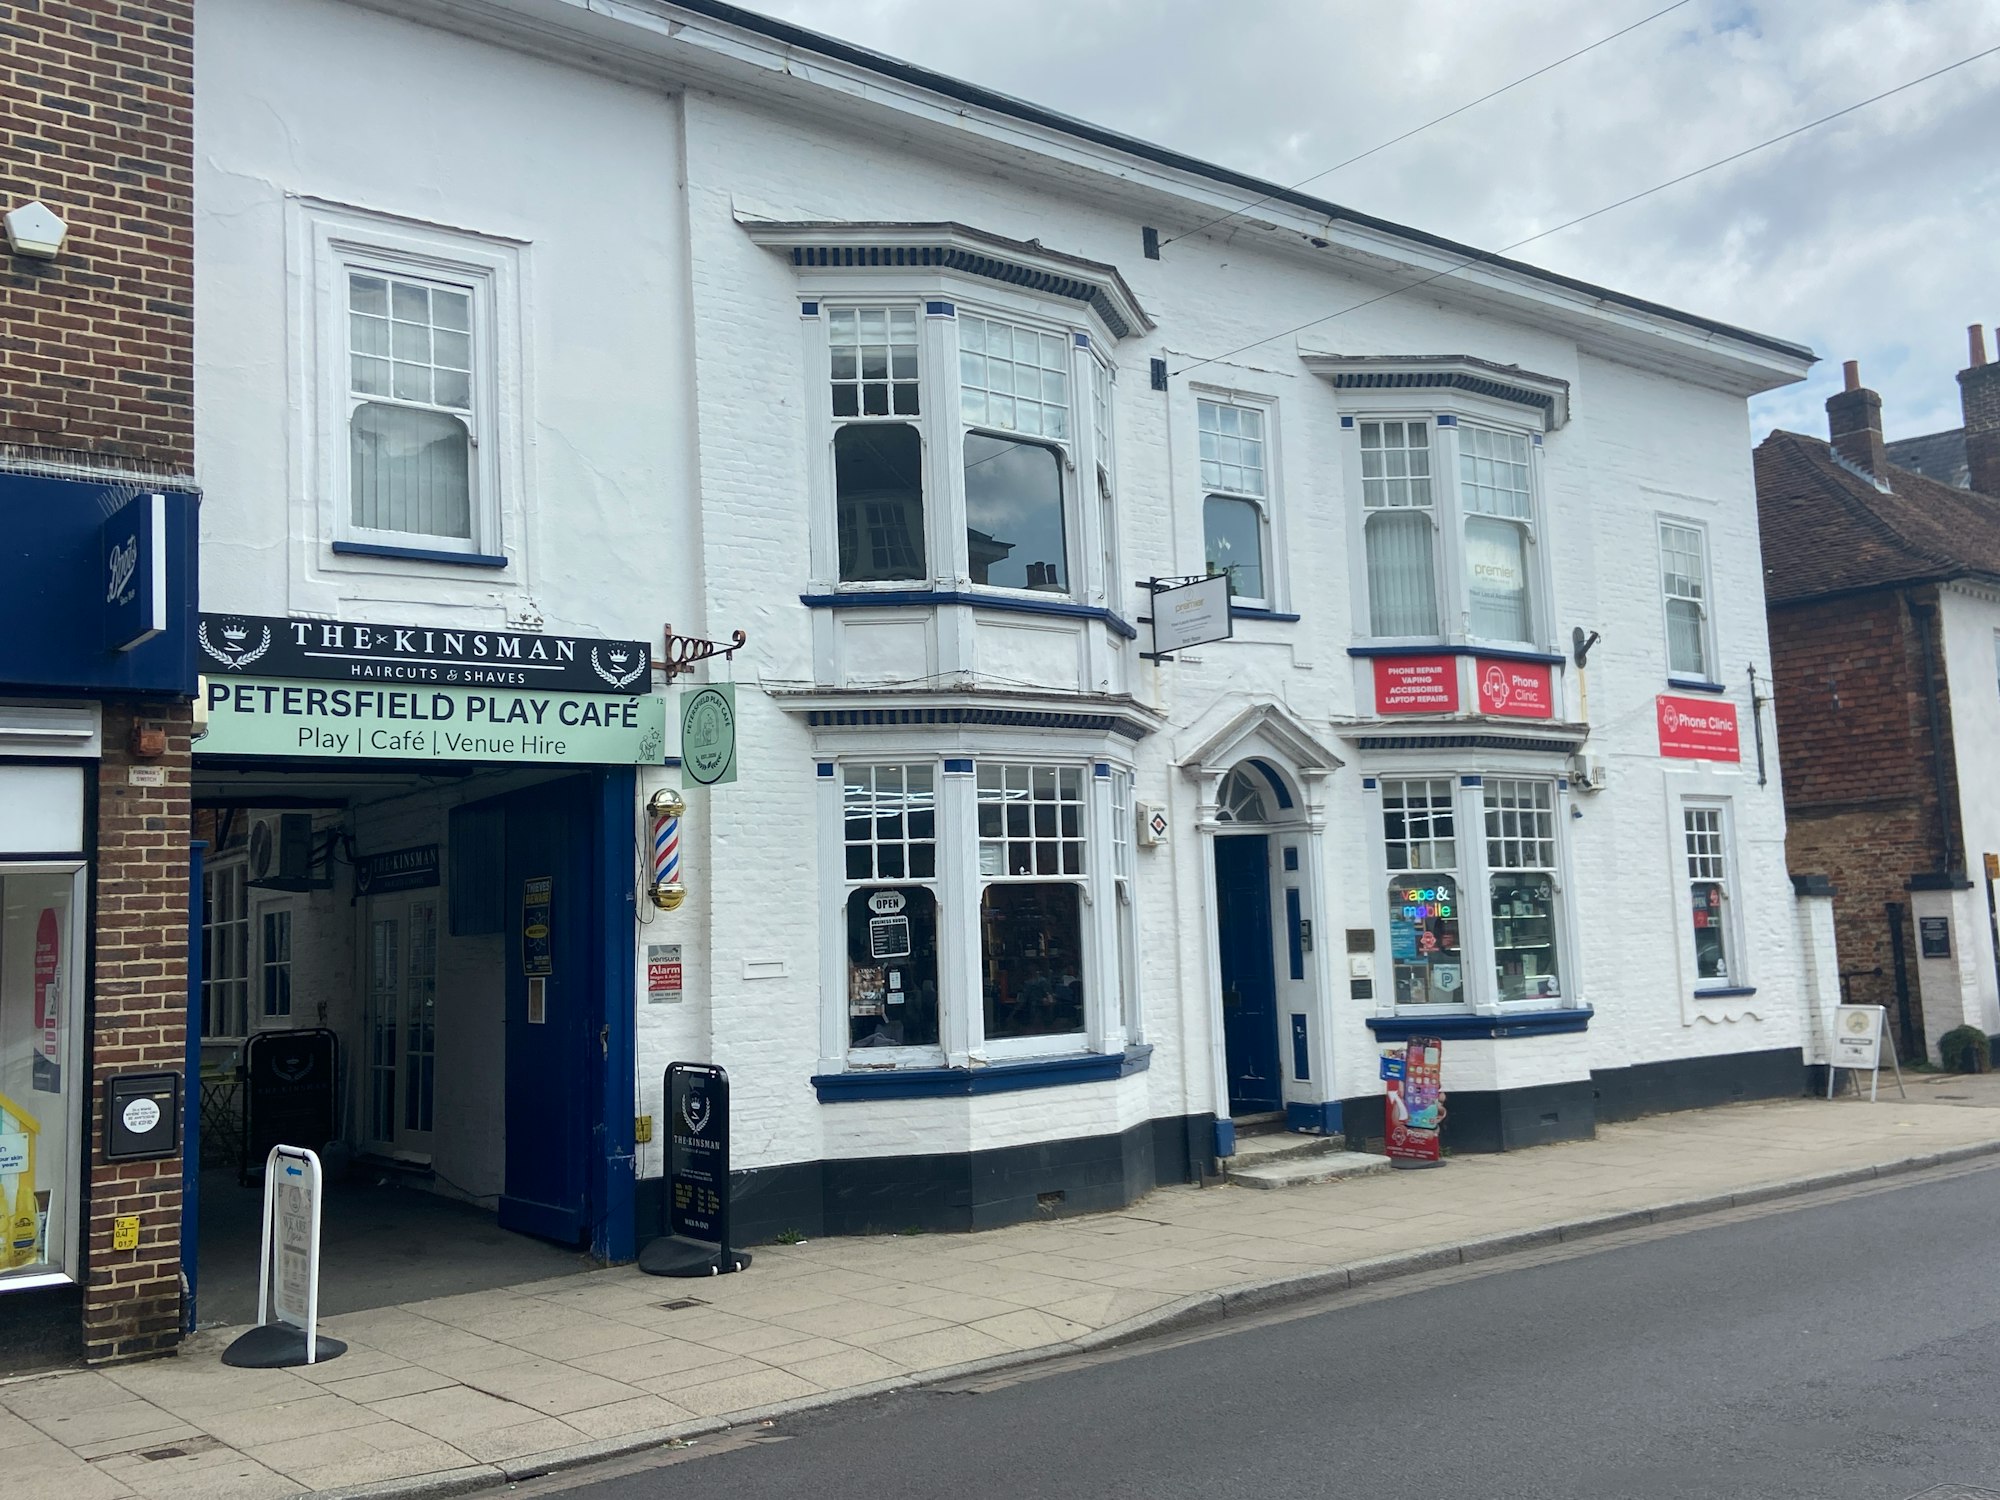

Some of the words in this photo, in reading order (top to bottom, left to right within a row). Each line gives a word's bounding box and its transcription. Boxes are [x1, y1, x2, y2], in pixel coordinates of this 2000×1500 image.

[106, 533, 138, 604] Boots
[1474, 564, 1515, 579] premier
[1175, 598, 1206, 614] premier
[290, 621, 374, 651] THE
[393, 629, 577, 662] KINSMAN
[351, 664, 439, 681] HAIRCUTS
[446, 668, 459, 682] &
[464, 670, 526, 685] SHAVES
[1387, 667, 1415, 676] PHONE
[1416, 666, 1443, 674] REPAIR
[1401, 676, 1433, 684] VAPING
[1512, 674, 1539, 689] Phone
[1390, 685, 1444, 694] ACCESSORIES
[1515, 688, 1538, 702] Clinic
[207, 683, 456, 721] PETERSFIELD
[466, 695, 551, 725] PLAY
[558, 697, 640, 729] CAFÉ
[710, 695, 723, 709] PLAY
[1385, 695, 1416, 704] LAPTOP
[1416, 694, 1449, 703] REPAIRS
[1679, 713, 1707, 729] Phone
[1708, 716, 1734, 732] Clinic
[298, 727, 350, 754] Play
[371, 730, 425, 751] Café
[445, 731, 515, 753] Venue
[521, 734, 567, 755] Hire
[393, 848, 437, 870] KINSMAN
[526, 880, 550, 894] THIEVES
[1401, 888, 1435, 904] vape
[1436, 885, 1451, 901] &
[876, 898, 900, 910] OPEN
[1403, 902, 1452, 918] mobile
[650, 965, 681, 975] Alarm
[673, 1134, 687, 1145] THE
[688, 1136, 721, 1150] KINSMAN
